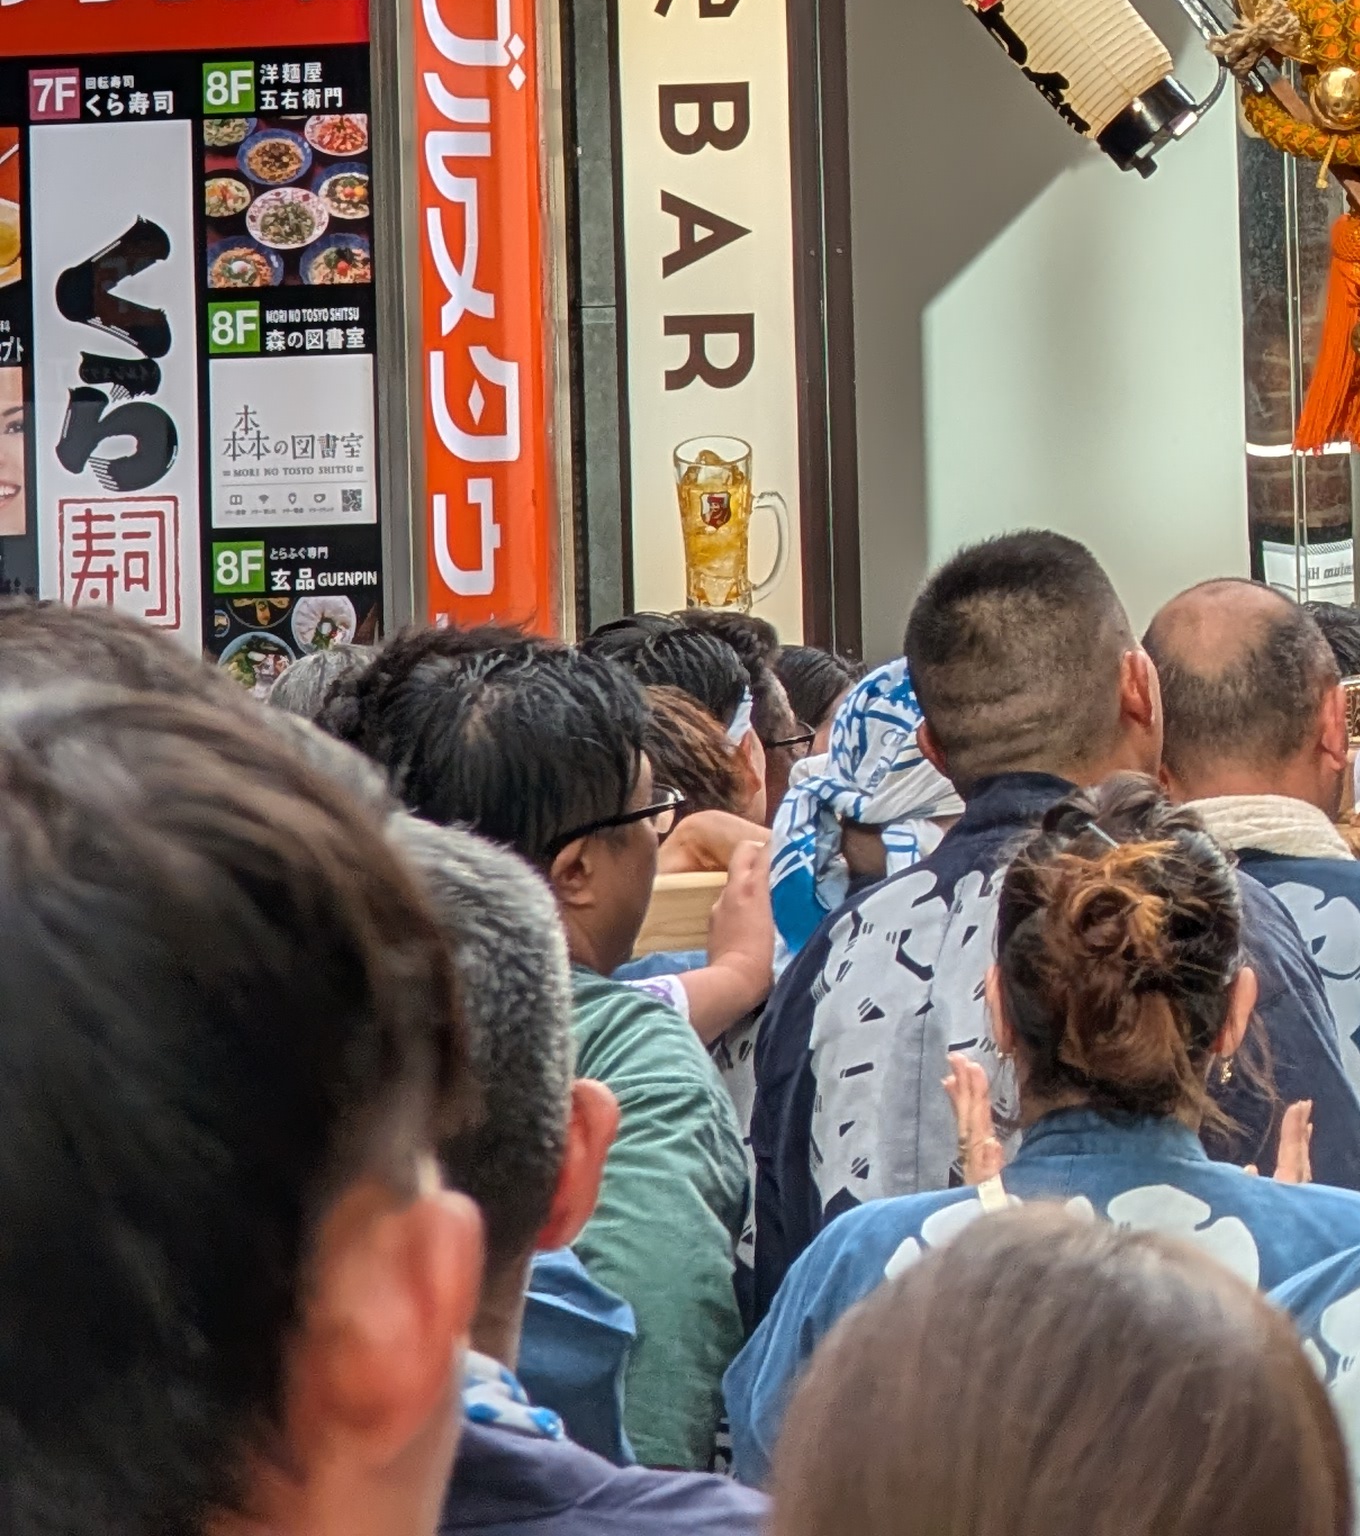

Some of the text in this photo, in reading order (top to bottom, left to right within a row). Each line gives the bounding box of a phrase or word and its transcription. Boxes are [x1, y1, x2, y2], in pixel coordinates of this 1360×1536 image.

[33, 75, 78, 113] 7F
[84, 75, 136, 90] 回転寿司
[206, 69, 253, 106] 8F
[84, 91, 175, 117] くら寿司
[259, 88, 343, 111] 五右衛門
[656, 80, 756, 393] BAR
[211, 309, 259, 346] 8F
[265, 327, 366, 352] 森の図書室
[55, 214, 179, 493] くら
[216, 550, 263, 586] 8F
[269, 545, 329, 561] とらふぐ専門
[270, 568, 378, 592] 玄品 GUENPIN
